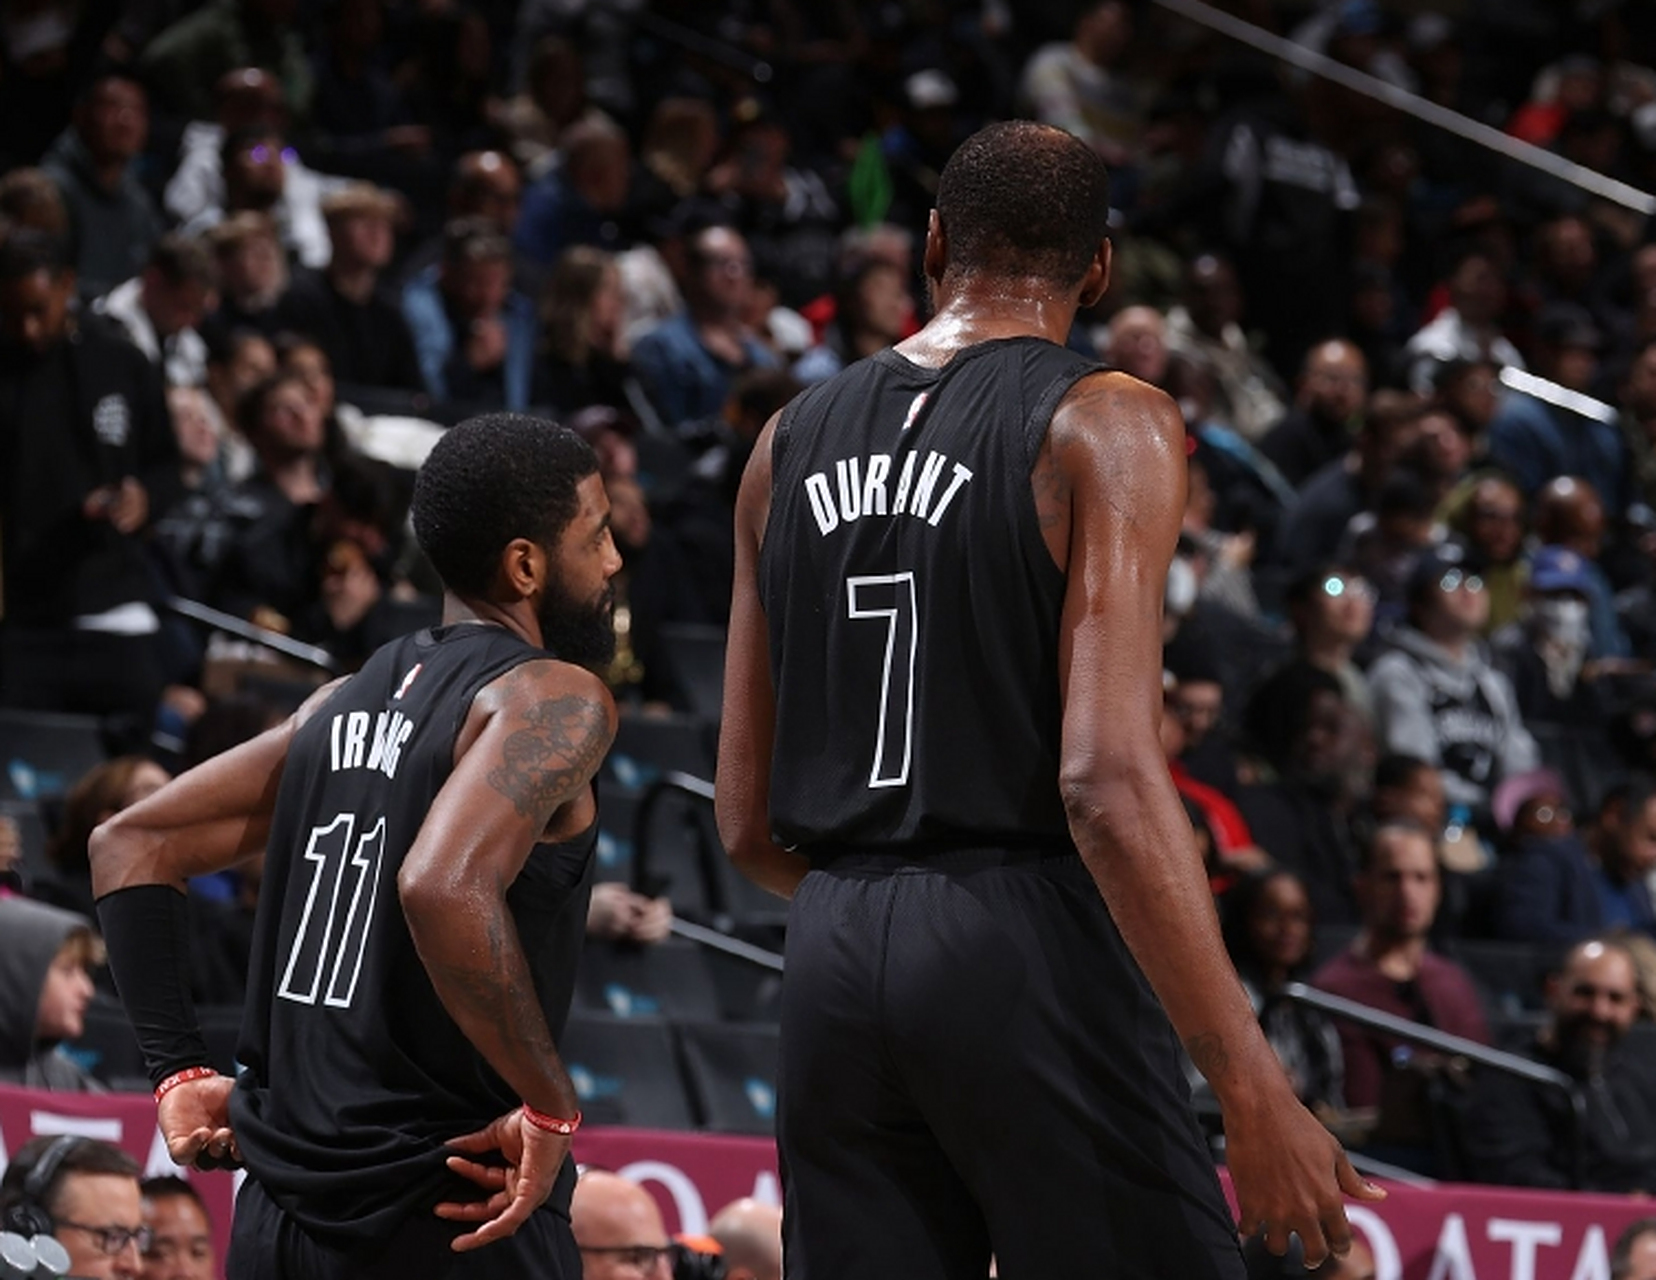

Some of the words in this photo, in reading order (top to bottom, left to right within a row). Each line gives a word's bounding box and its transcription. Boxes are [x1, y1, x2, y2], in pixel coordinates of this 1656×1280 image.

[804, 450, 973, 536] DURANT
[331, 710, 414, 779] IRNG
[847, 571, 917, 788] 7
[277, 813, 385, 1008] 11
